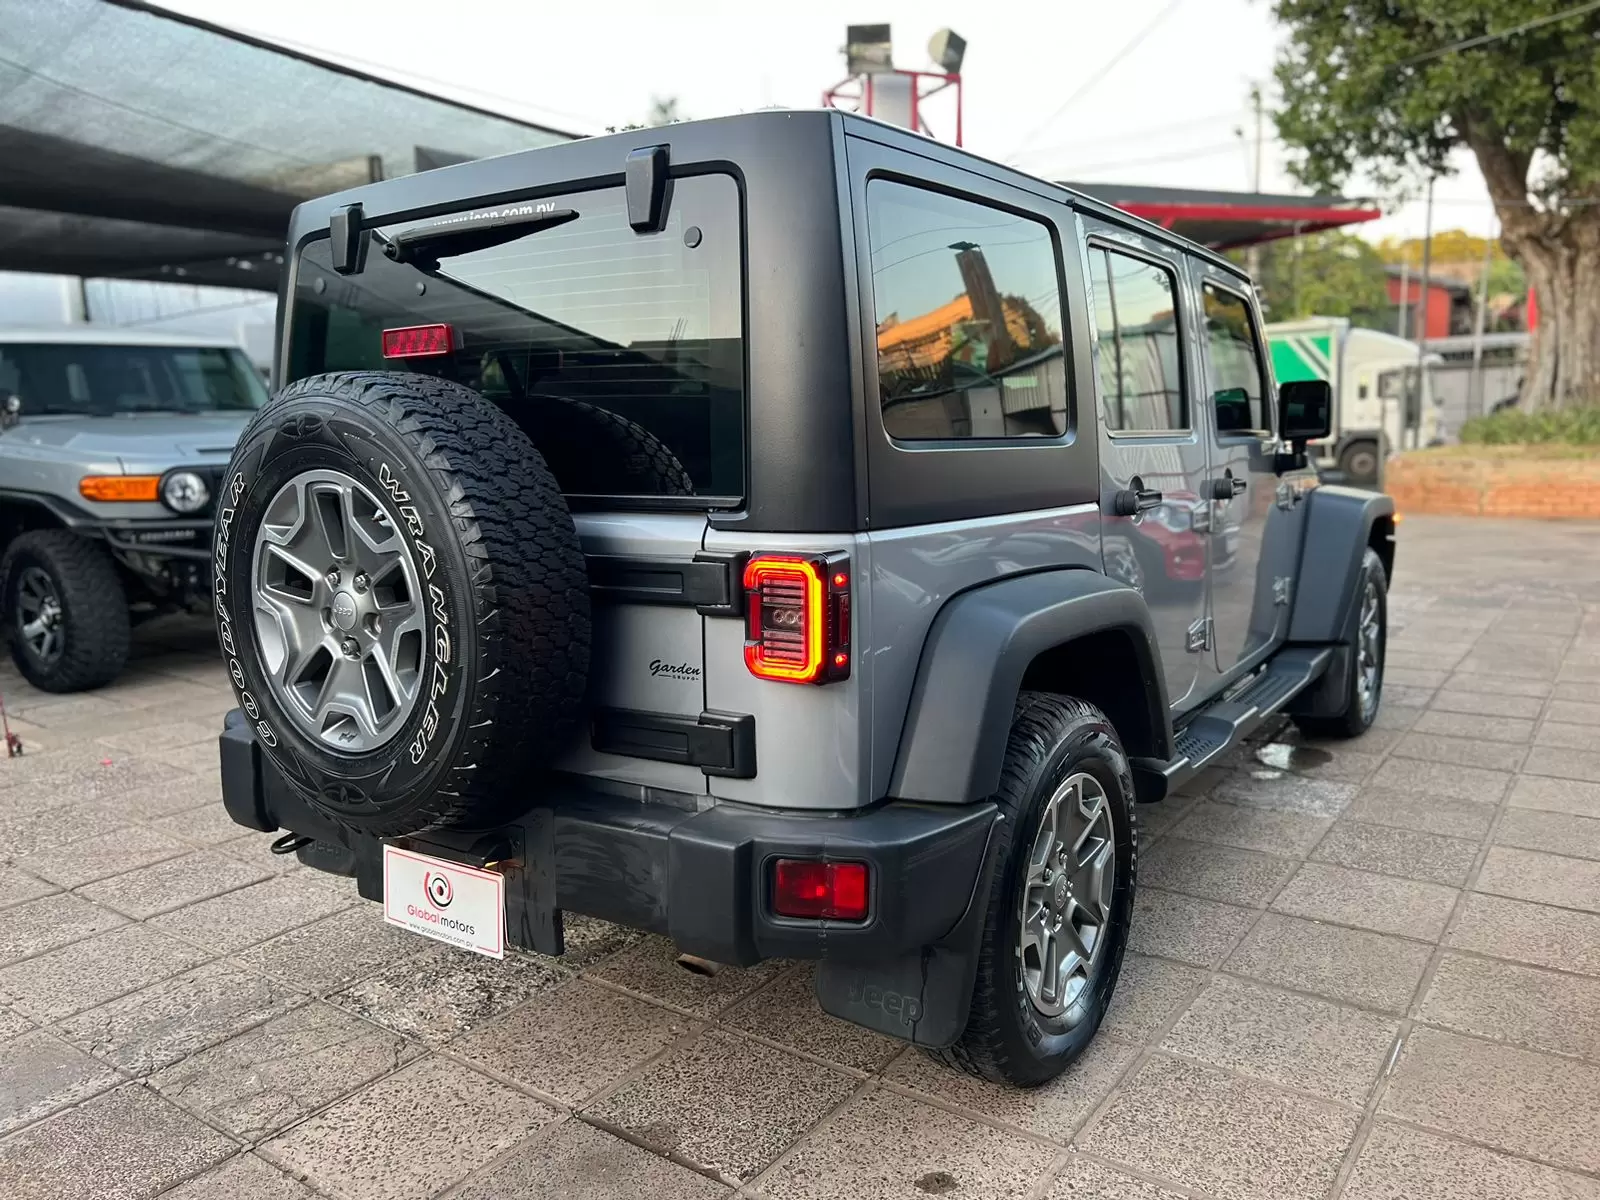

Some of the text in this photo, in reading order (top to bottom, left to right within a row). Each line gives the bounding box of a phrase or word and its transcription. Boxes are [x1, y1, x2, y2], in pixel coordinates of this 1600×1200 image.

[215, 472, 278, 749] GOODYEAR
[378, 462, 451, 766] WRANGLER
[649, 659, 701, 676] Garden
[846, 975, 924, 1027] Jeep
